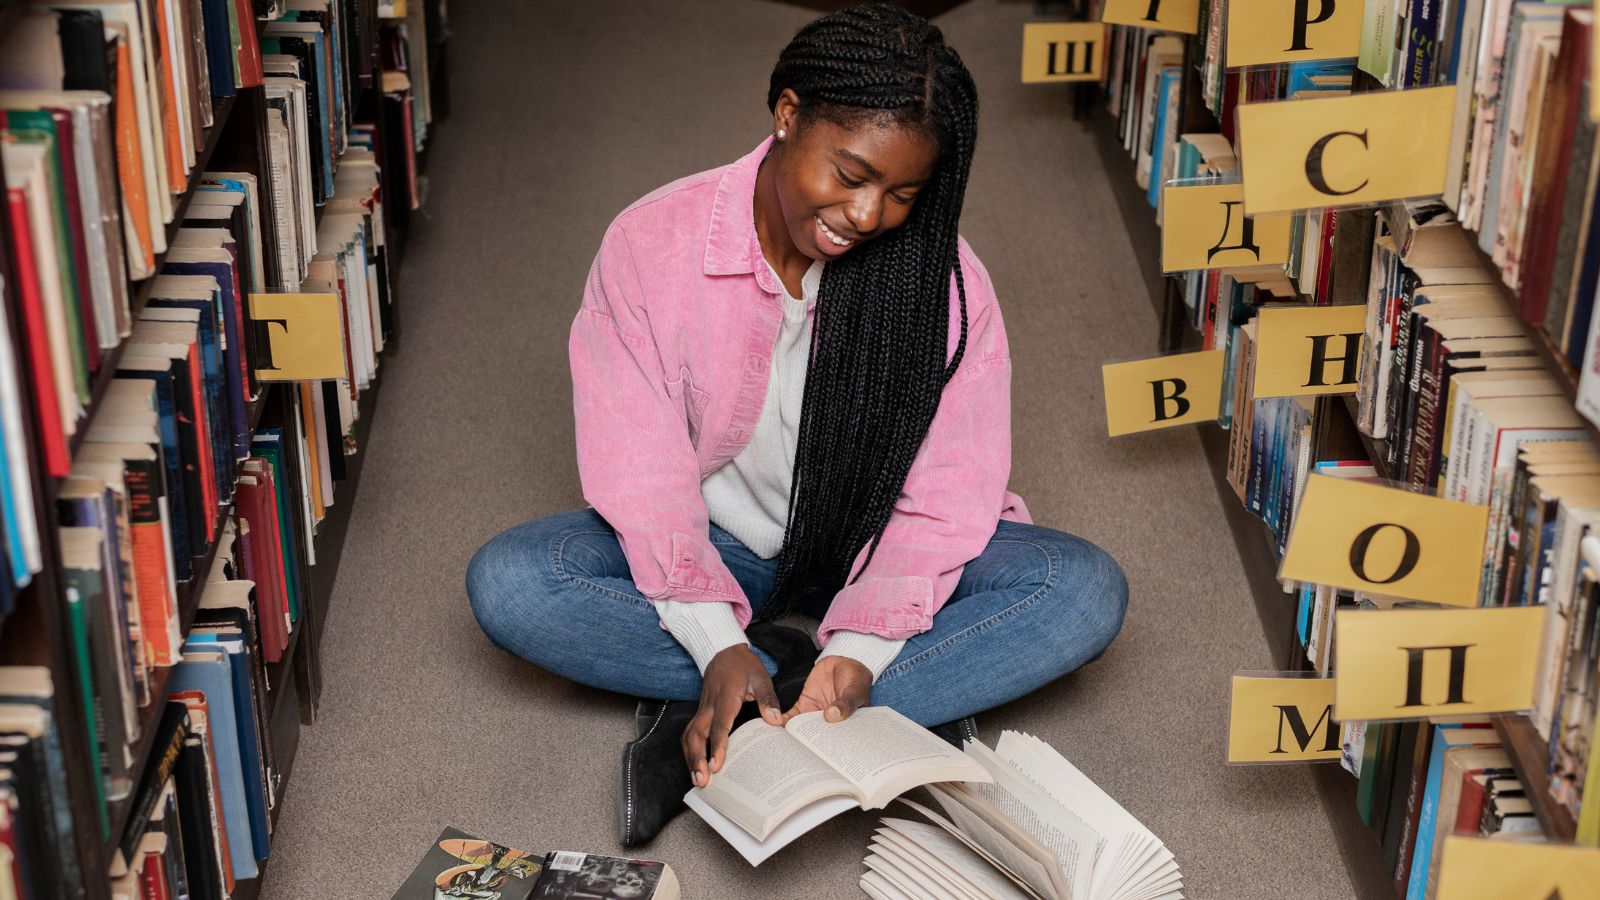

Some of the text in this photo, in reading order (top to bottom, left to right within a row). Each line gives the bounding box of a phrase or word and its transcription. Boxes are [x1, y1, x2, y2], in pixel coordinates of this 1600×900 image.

[1285, 0, 1337, 52] Р
[1046, 41, 1095, 76] Ш
[1304, 130, 1370, 196] С
[1207, 201, 1260, 264] Д
[251, 319, 288, 371] Г
[1300, 333, 1361, 388] Н
[1410, 338, 1425, 393] Фантом
[1148, 377, 1191, 423] В
[1349, 522, 1421, 584] О
[1396, 643, 1478, 708] П
[1269, 704, 1342, 754] М
